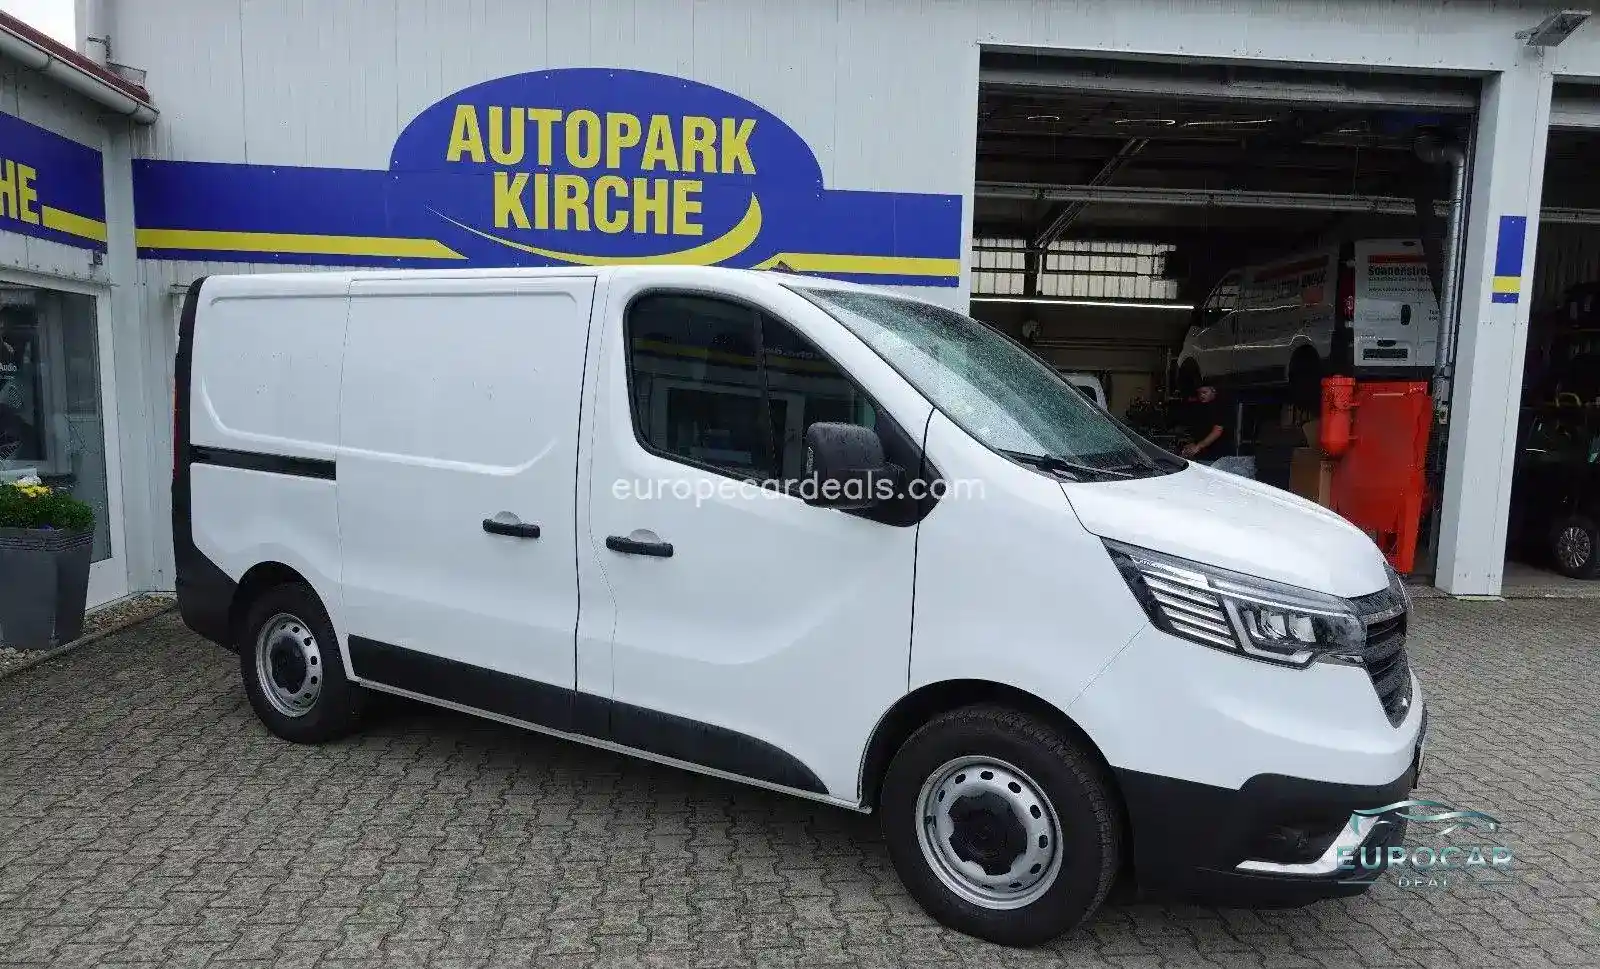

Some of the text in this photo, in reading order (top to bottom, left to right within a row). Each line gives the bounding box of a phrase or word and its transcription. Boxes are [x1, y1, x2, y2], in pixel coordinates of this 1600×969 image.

[446, 104, 758, 175] AUTOPARK
[0, 158, 40, 225] HE
[493, 171, 703, 236] KIRCHE
